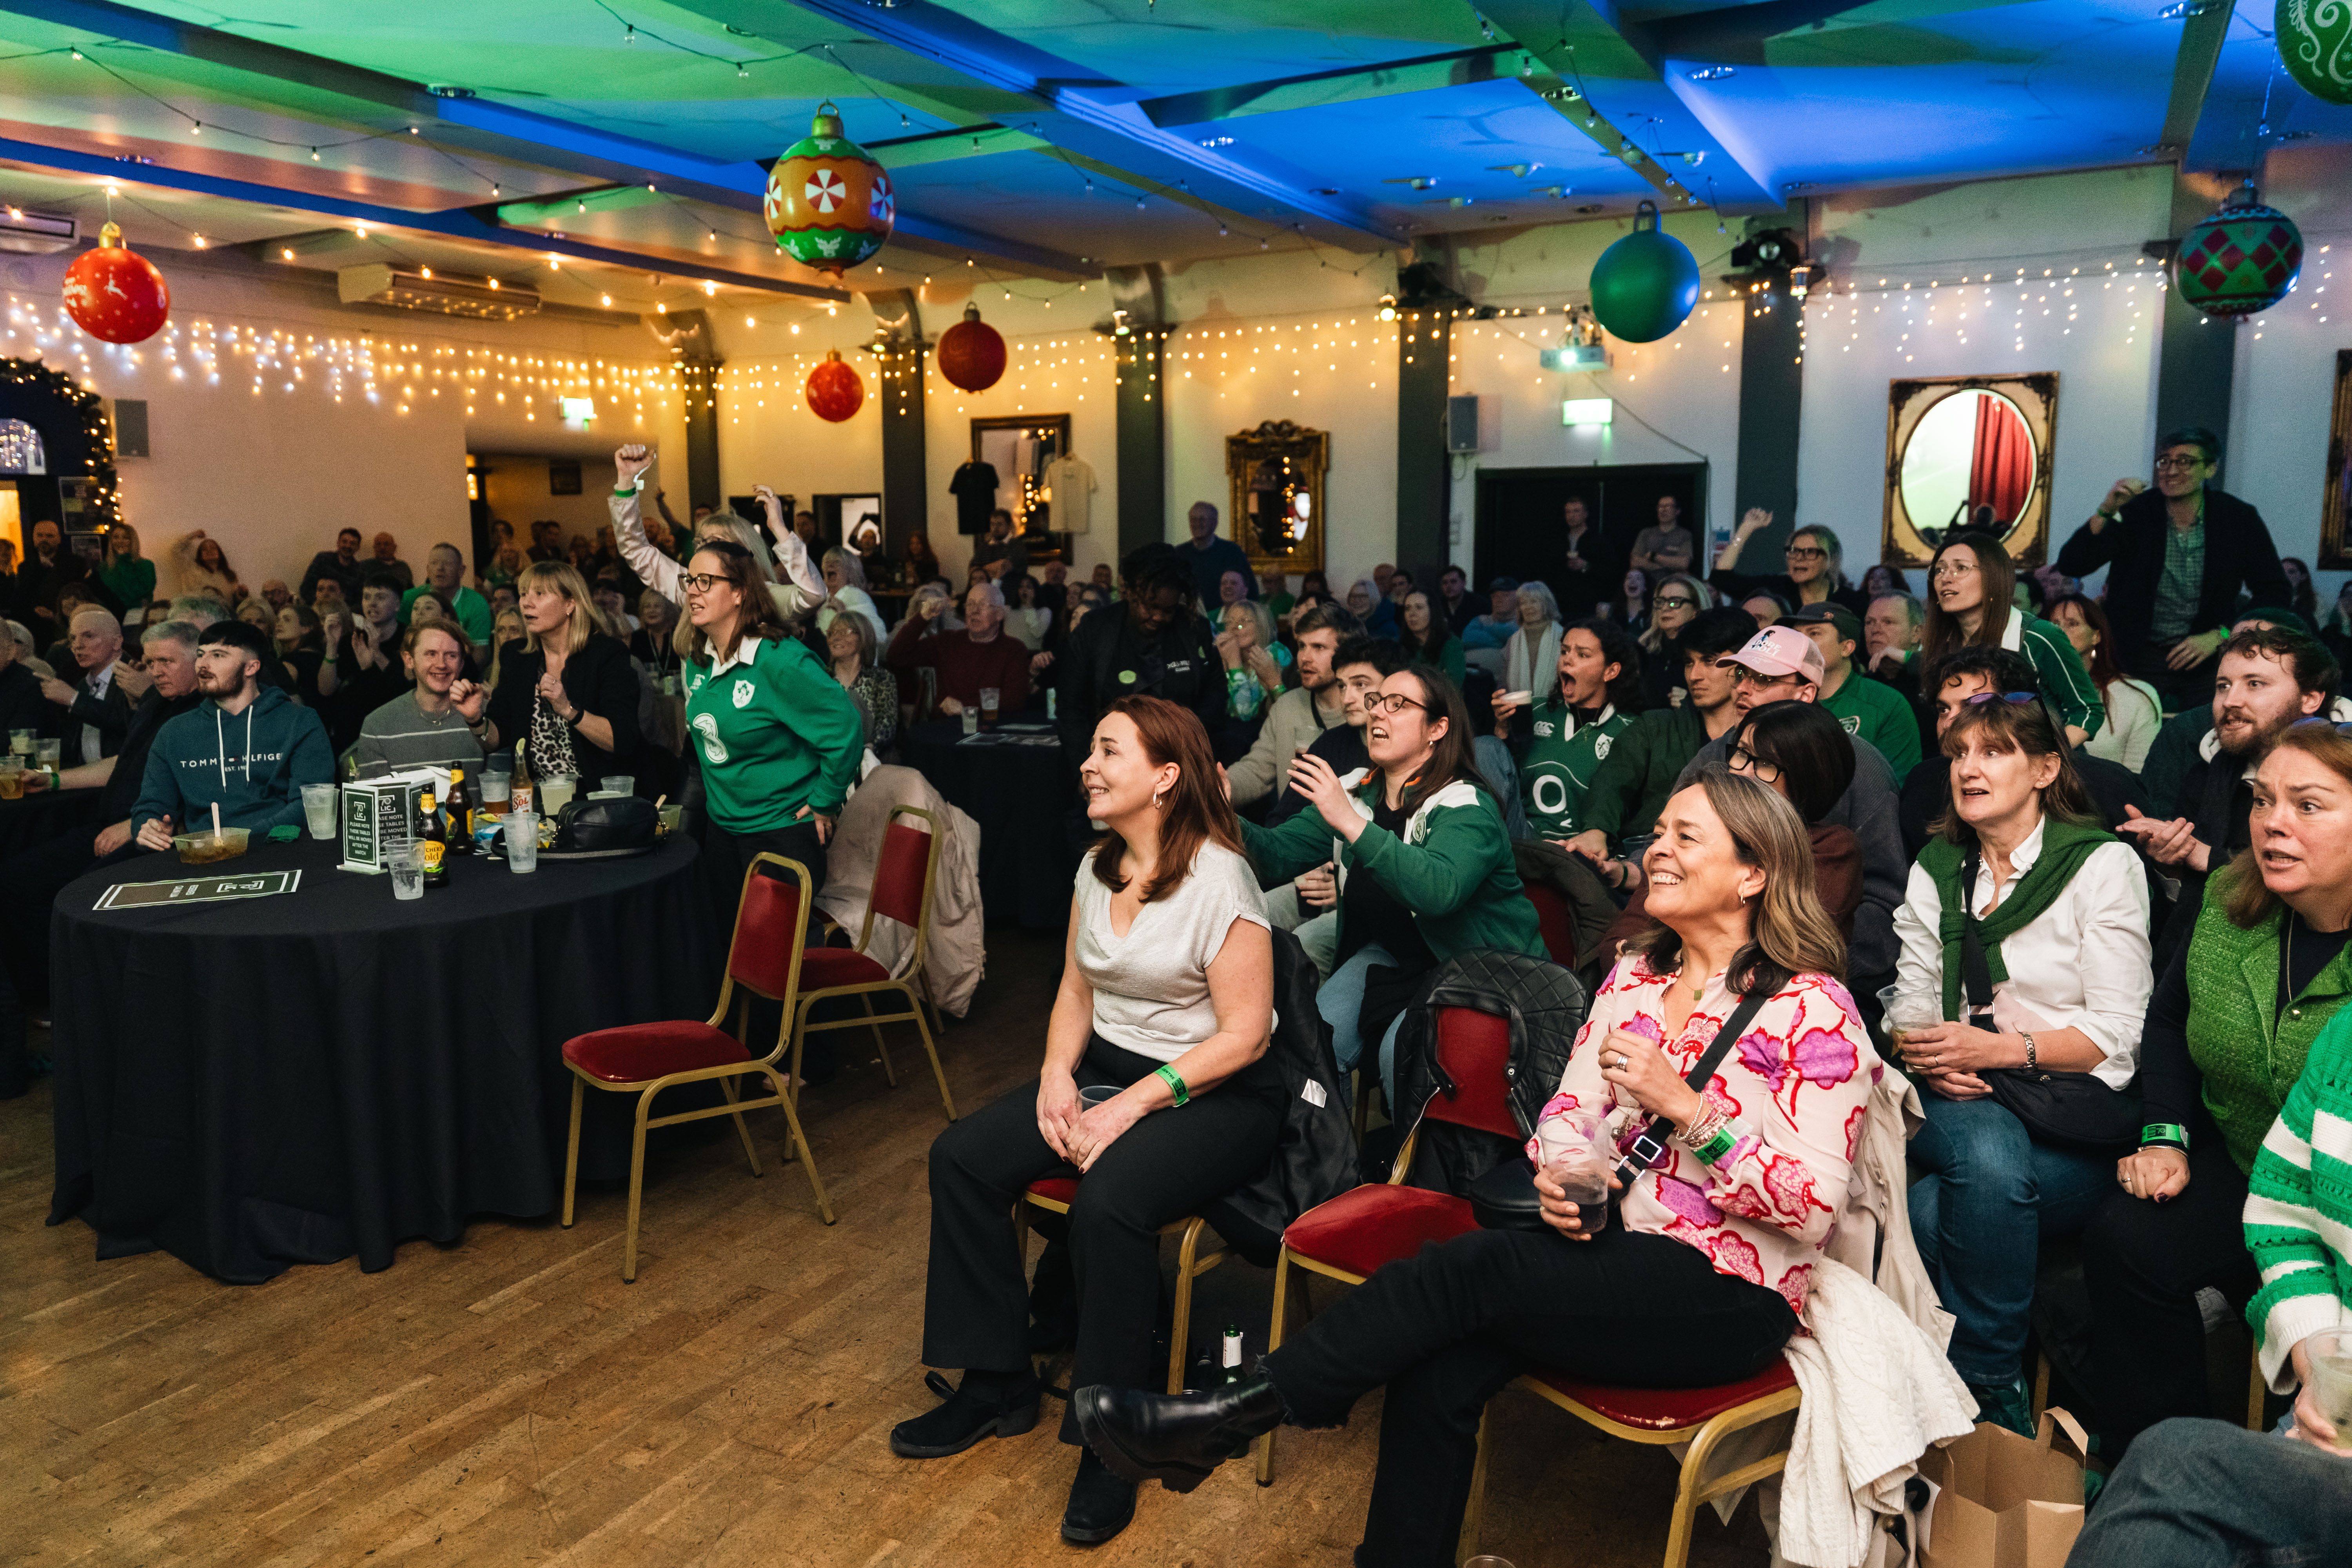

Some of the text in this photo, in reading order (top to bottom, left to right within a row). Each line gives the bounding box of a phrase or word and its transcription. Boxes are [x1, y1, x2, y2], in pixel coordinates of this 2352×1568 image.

[1752, 639, 1782, 650] DORE
[242, 753, 283, 762] HLFIGE
[425, 852, 439, 860] old
[1161, 1068, 1175, 1080] CENTRE
